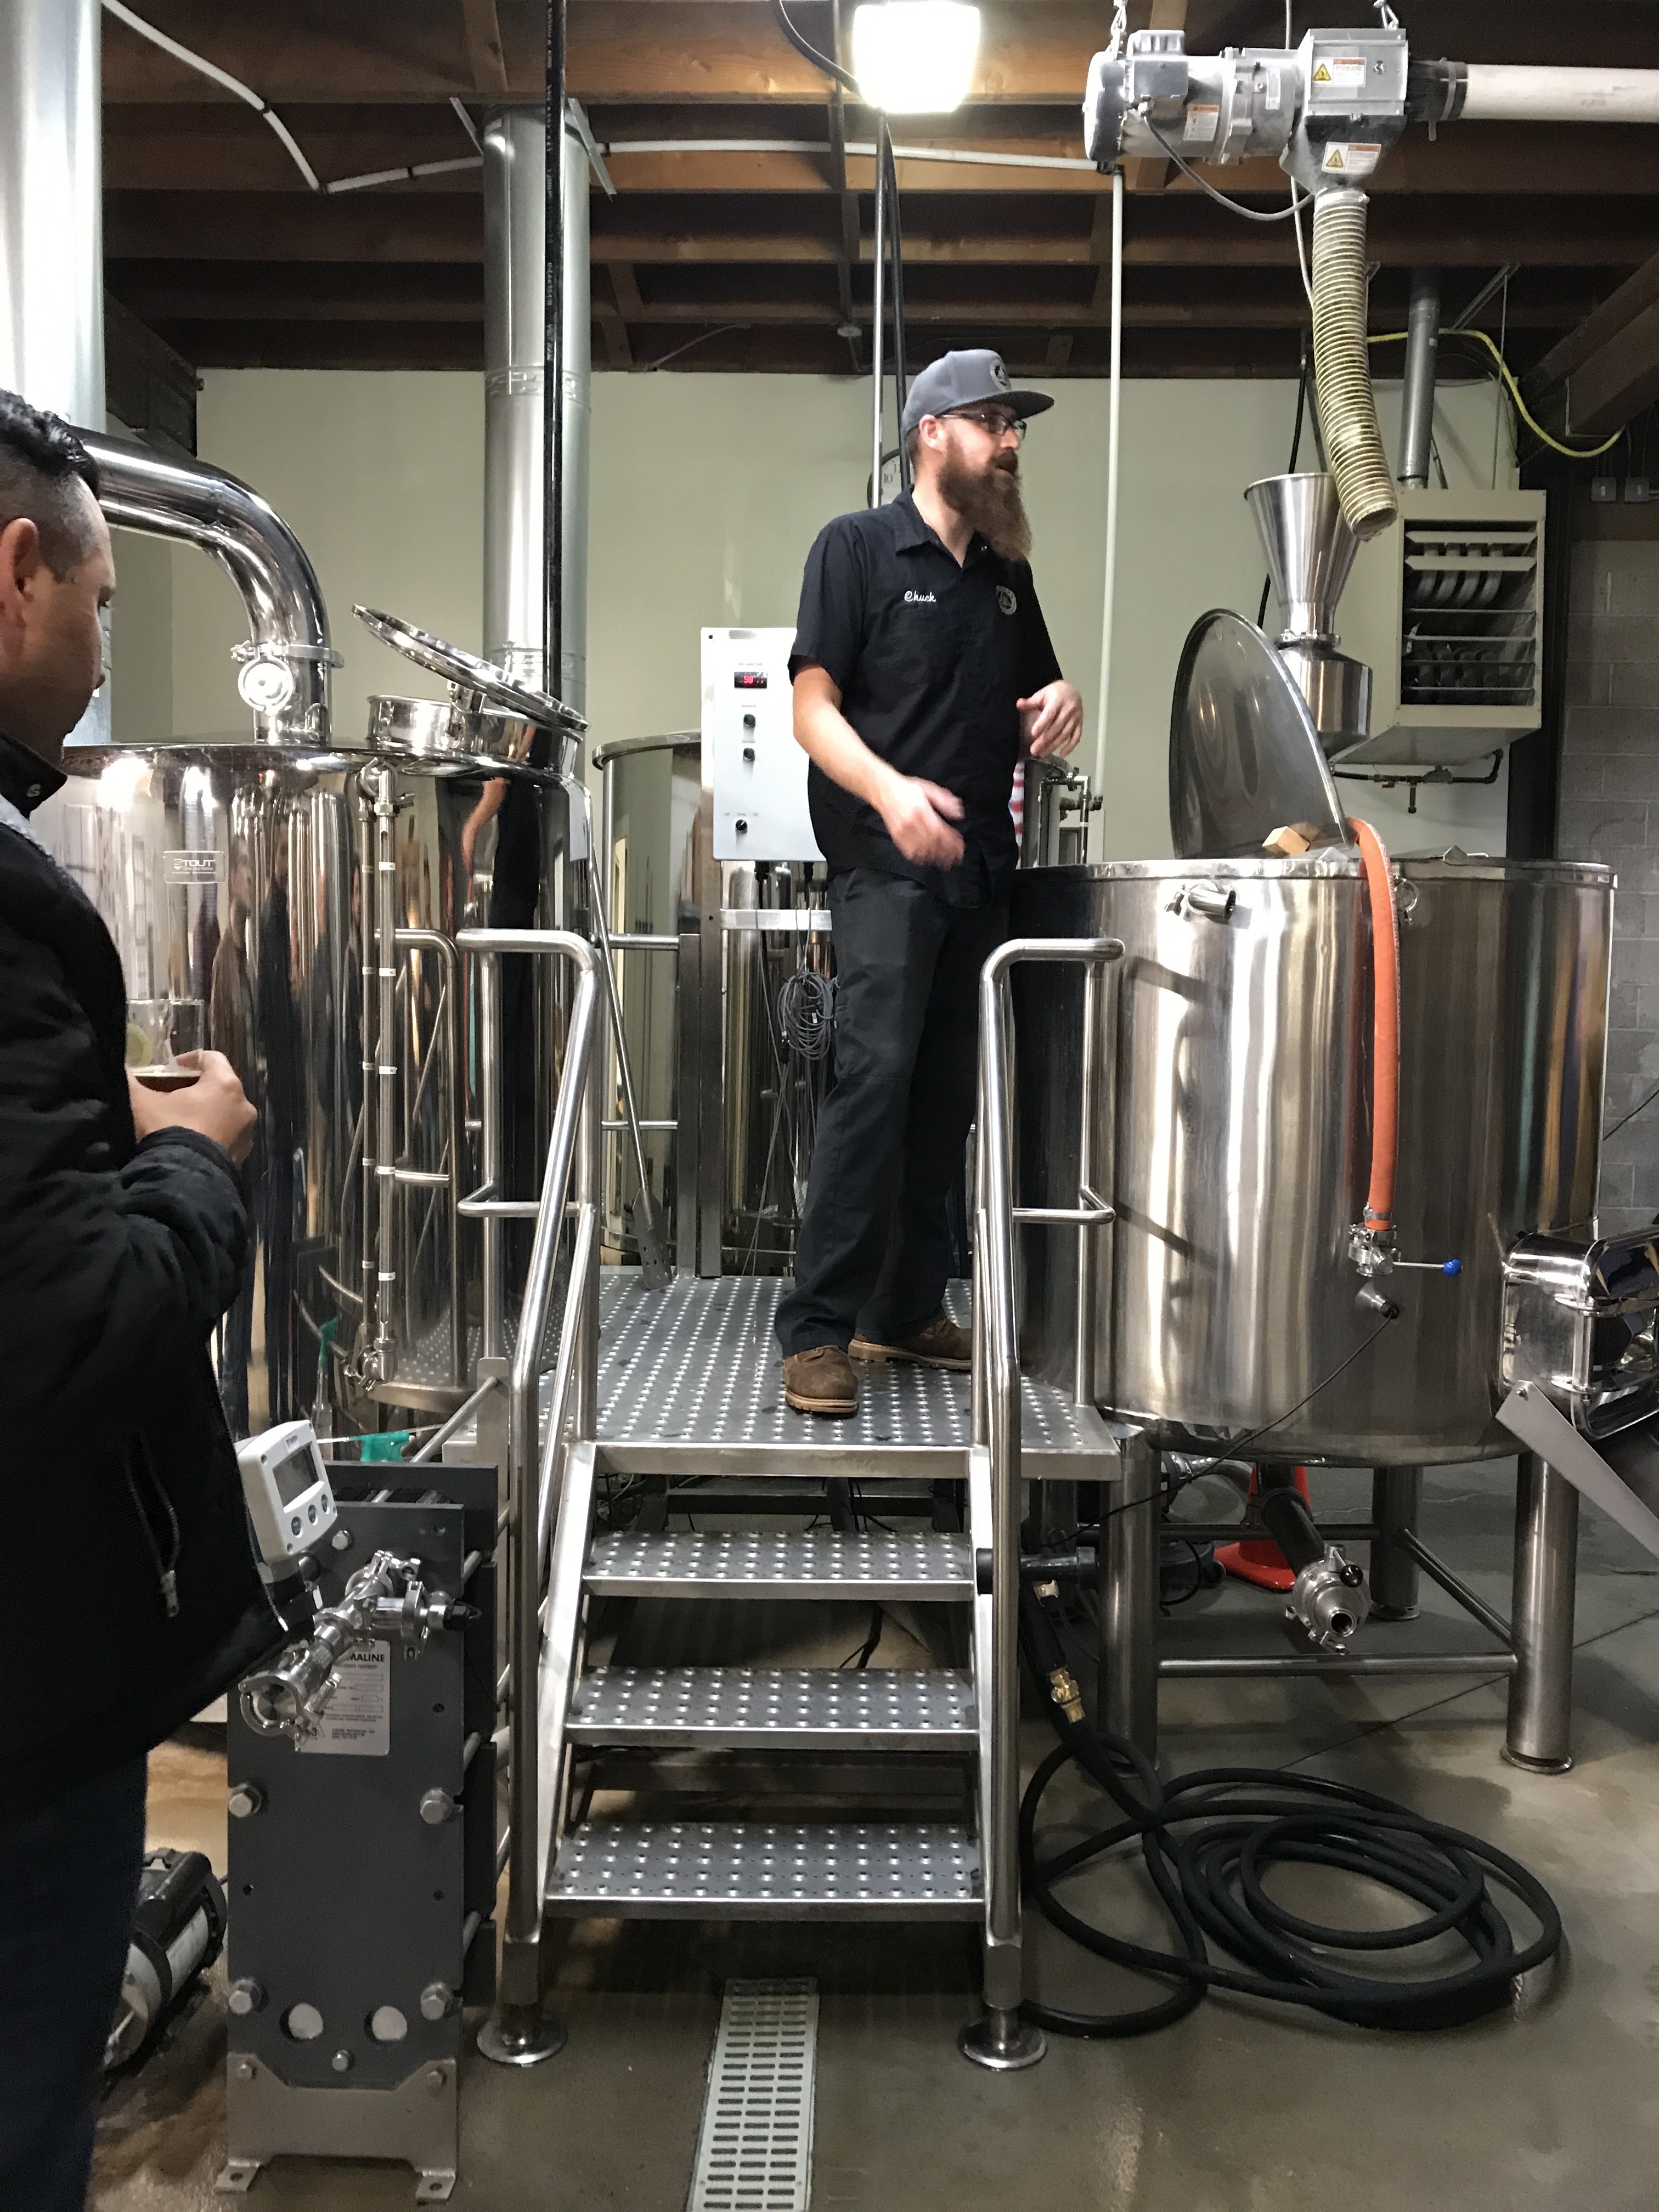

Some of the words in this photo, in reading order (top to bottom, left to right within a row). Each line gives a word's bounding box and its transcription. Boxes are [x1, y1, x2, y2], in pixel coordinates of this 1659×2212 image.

[884, 473, 893, 483] 10
[904, 590, 936, 602] Chuck
[173, 858, 215, 870] STOUT
